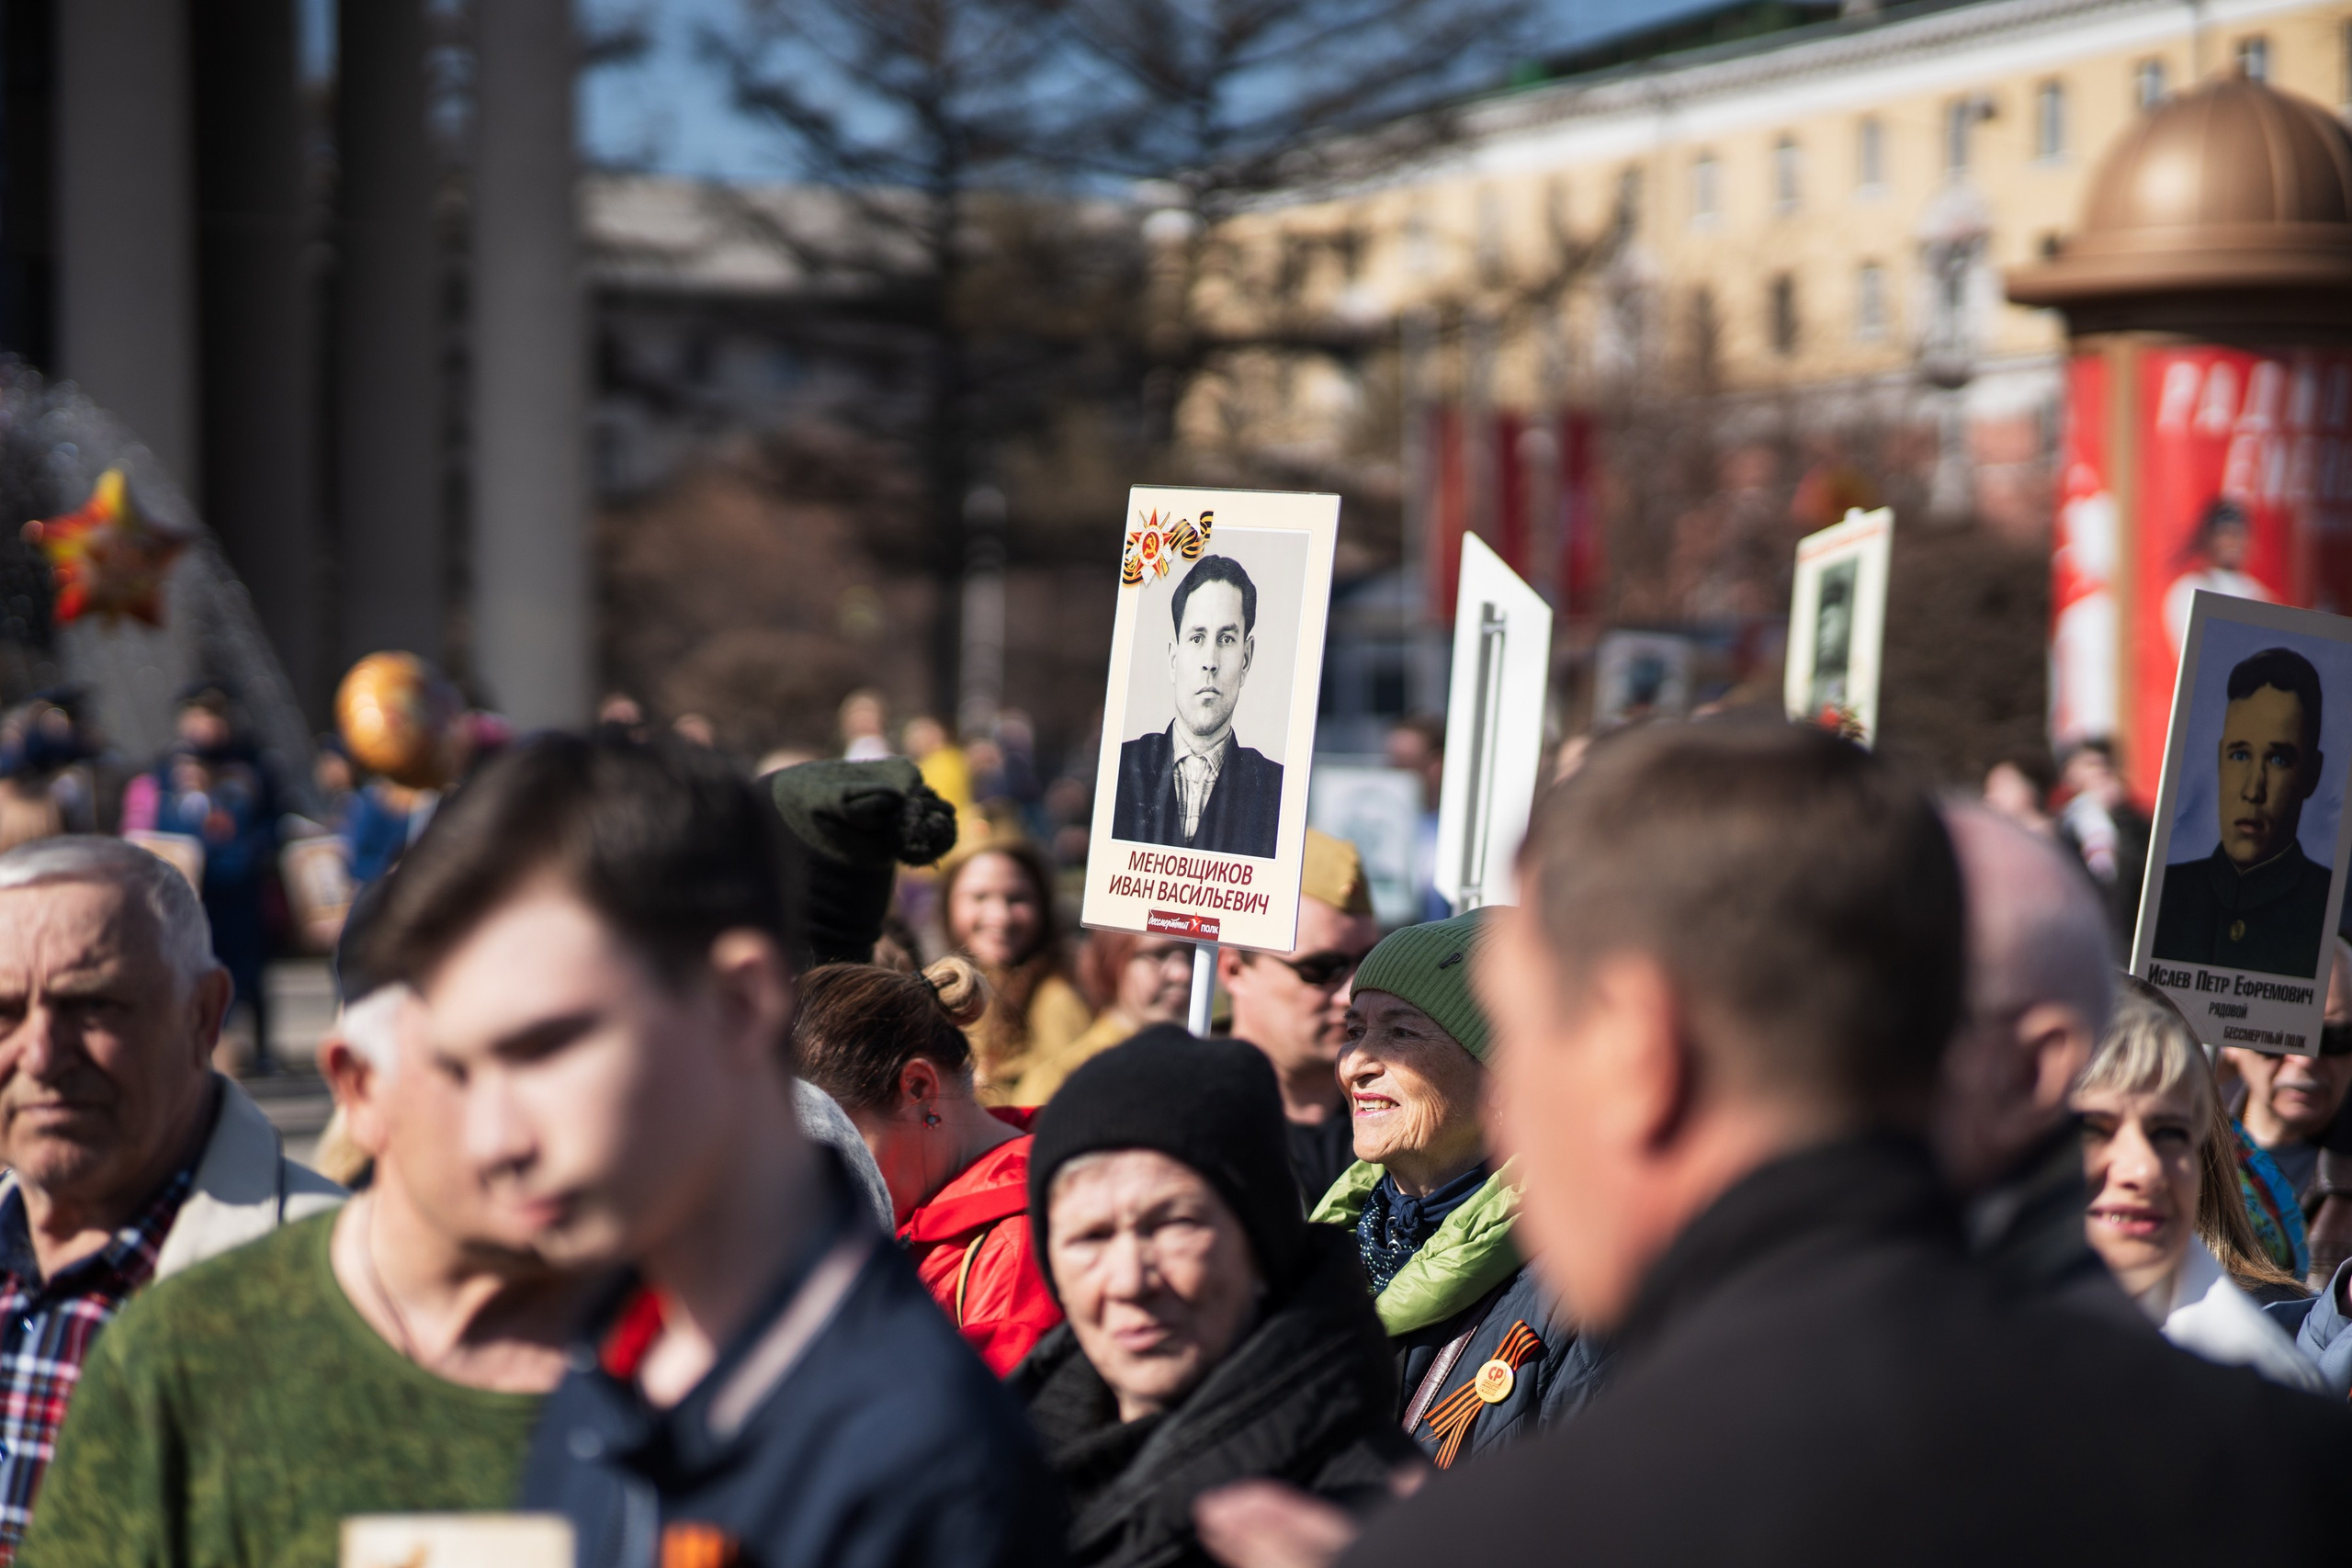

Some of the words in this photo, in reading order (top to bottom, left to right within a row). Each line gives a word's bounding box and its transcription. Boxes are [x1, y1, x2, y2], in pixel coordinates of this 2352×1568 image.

[1128, 851, 1253, 886] МЕНОВЩИКОВ
[1108, 874, 1155, 899] ИВАН
[1157, 880, 1270, 915] ВАСИЛЬЕВИЧ
[2208, 1001, 2248, 1020] РЯДОВОЙ
[2223, 1025, 2283, 1045] БЕССМЕРТНЫЙ
[2284, 1032, 2306, 1049] ПОЛК
